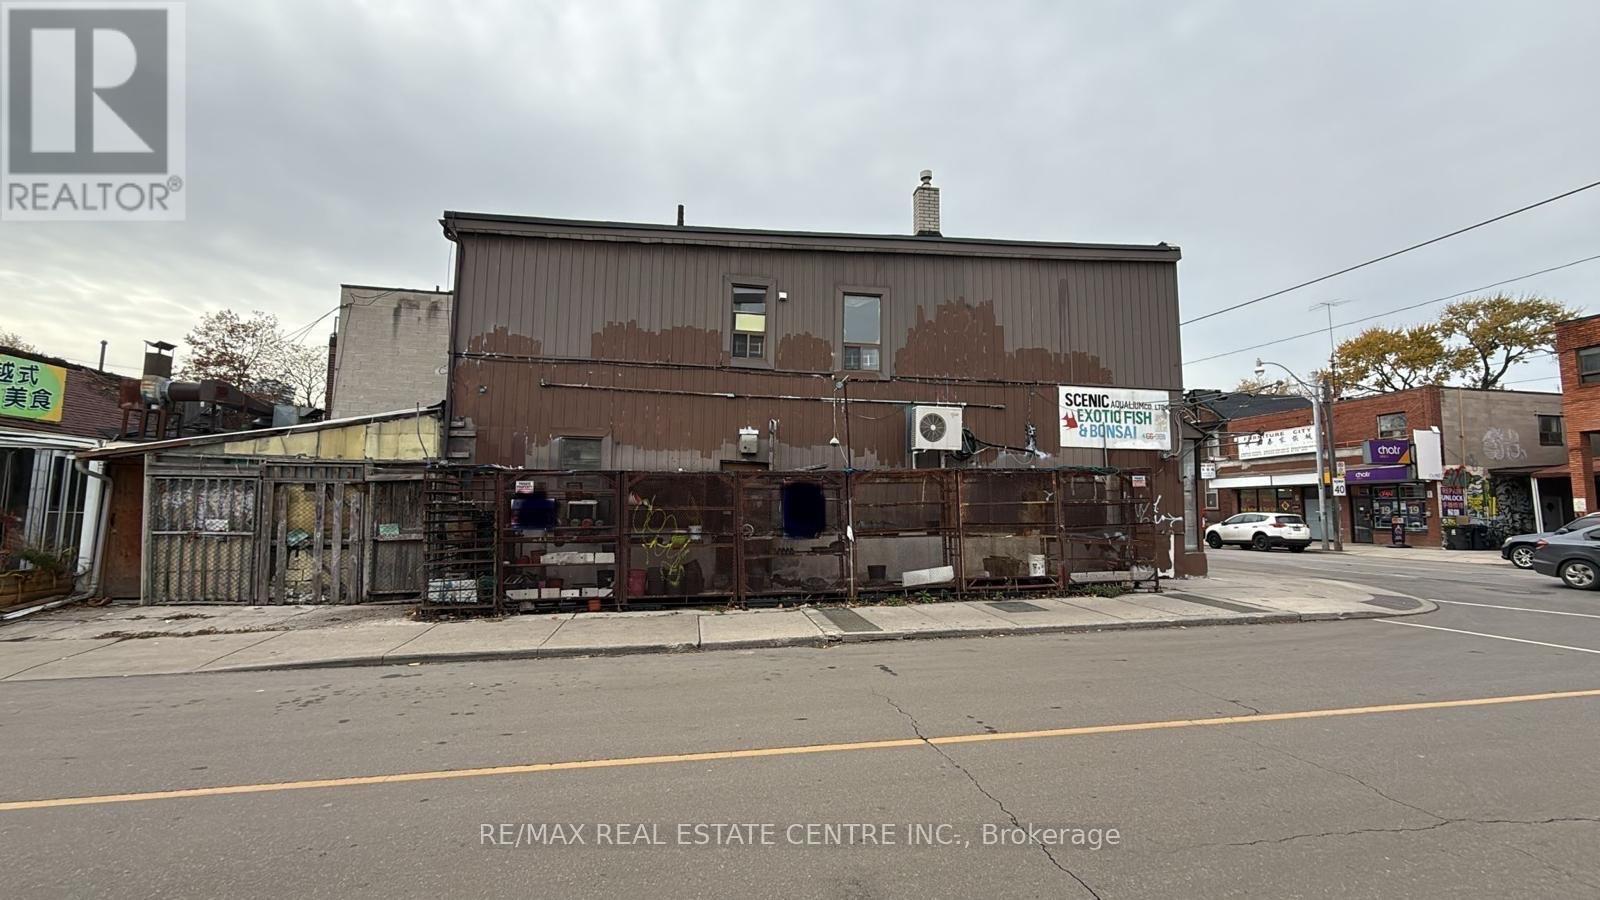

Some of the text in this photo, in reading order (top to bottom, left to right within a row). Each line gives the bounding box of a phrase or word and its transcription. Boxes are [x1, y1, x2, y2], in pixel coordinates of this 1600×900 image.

[4, 386, 52, 410] 美食
[1065, 393, 1109, 408] SCENIC
[1124, 411, 1152, 425] FISH
[1079, 424, 1087, 438] &
[1090, 424, 1137, 439] BONSAI
[1292, 427, 1311, 435] CITY
[1334, 485, 1345, 494] 40
[1408, 505, 1420, 514] 19
